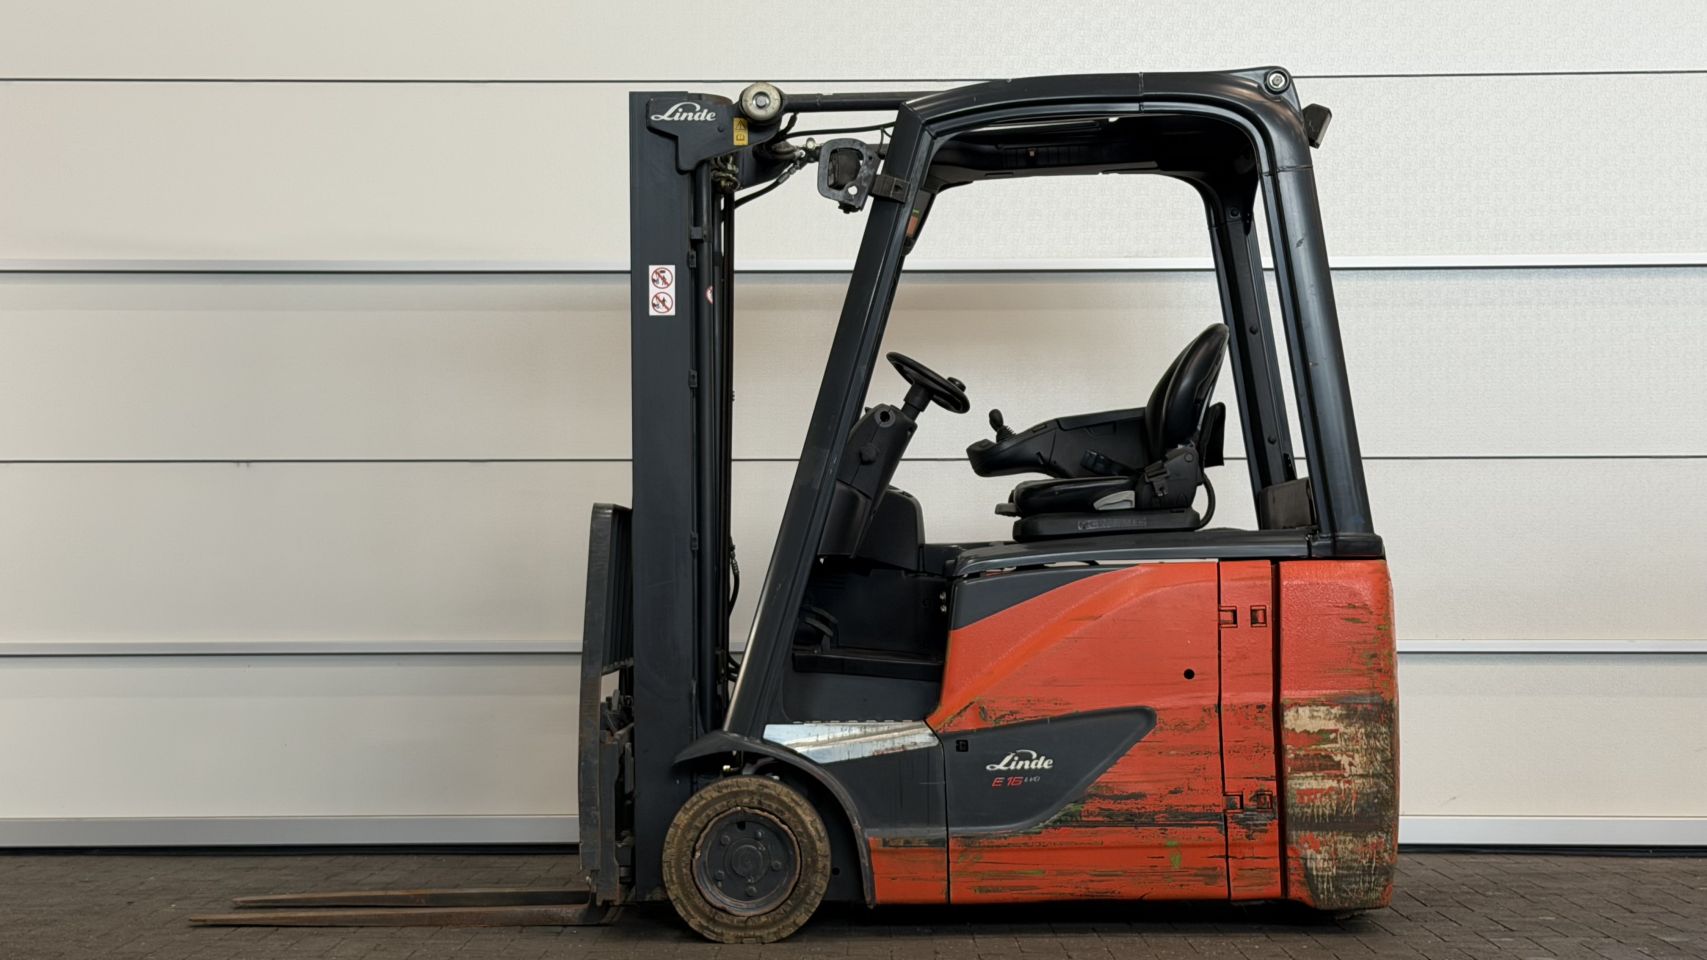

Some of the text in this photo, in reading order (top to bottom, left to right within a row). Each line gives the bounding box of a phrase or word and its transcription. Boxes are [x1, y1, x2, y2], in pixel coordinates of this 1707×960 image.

[650, 101, 716, 121] Linde
[986, 749, 1053, 770] Linde
[992, 776, 1005, 787] E
